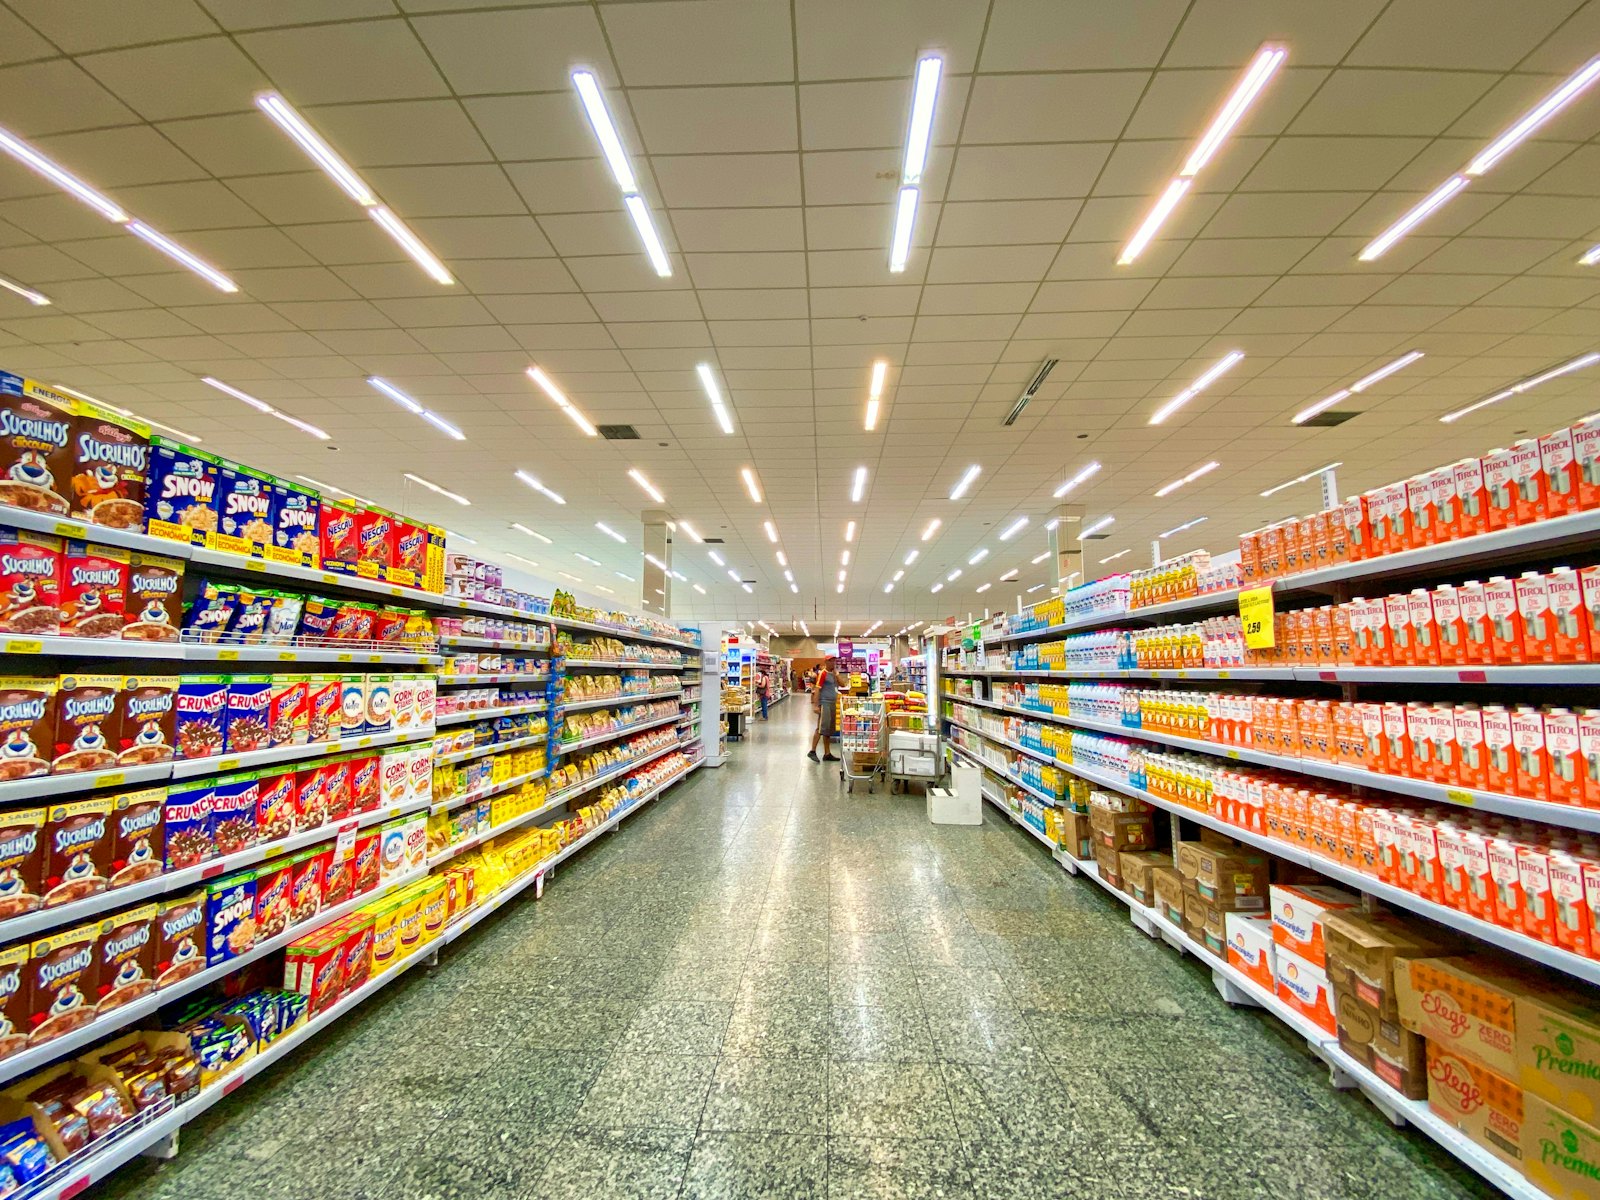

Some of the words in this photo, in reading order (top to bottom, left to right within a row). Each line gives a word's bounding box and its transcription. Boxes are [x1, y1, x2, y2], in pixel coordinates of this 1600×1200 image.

[0, 410, 69, 447] SUCRILHOS
[80, 434, 146, 471] SUCRILHOS
[1542, 440, 1572, 454] TIROL
[1484, 459, 1511, 473] TIROL
[1512, 451, 1538, 465] TIROL
[1431, 478, 1454, 489] TIROL
[1456, 469, 1480, 481] TIROL
[162, 475, 215, 498] SNOW
[226, 492, 270, 514] SNOW
[279, 508, 316, 528] SNOW
[328, 517, 354, 537] NESCAU
[150, 527, 190, 542] ECONÔMICA
[361, 521, 390, 543] NESCAU
[399, 533, 424, 553] NESCAU
[2, 555, 54, 576] SUCRILHOS
[72, 567, 120, 586] SUCRILHOS
[133, 574, 177, 593] SUCRILHOS
[1487, 591, 1513, 601] TIROL
[1519, 587, 1546, 597] TIROL
[1549, 583, 1577, 593] TIROL
[1434, 599, 1457, 608] TIROL
[1460, 595, 1483, 604] TIROL
[194, 608, 233, 625] SNOW
[177, 690, 226, 710] CRUNCH
[228, 689, 271, 709] CRUNCH
[278, 687, 305, 711] NESCAU
[315, 687, 339, 708] NESCAU
[394, 689, 412, 704] CORN
[417, 689, 433, 702] CORN
[0, 698, 47, 720] CRILHOS
[65, 694, 116, 720] SUCRILHOS
[128, 694, 173, 718] SUCRILHOS
[1429, 717, 1453, 726] TIROL
[1455, 719, 1479, 729] TIROL
[1485, 721, 1509, 730] TIROL
[1513, 722, 1541, 733] TIROL
[1546, 724, 1576, 735] TIROL
[355, 761, 377, 787] NESCAU
[385, 761, 405, 778] CORN
[411, 757, 429, 772] CORN
[214, 787, 258, 810] CRUNCH
[261, 781, 292, 812] NESCAU
[300, 774, 326, 803] NESCAU
[166, 797, 214, 820] CRUNCH
[120, 806, 161, 838] SUCRILHOS
[56, 818, 105, 853] SUCRILHOS
[408, 828, 425, 846] CORN
[356, 838, 380, 867] NESCAU
[293, 861, 319, 899] NESCAU
[1550, 869, 1579, 884] TIROL
[163, 906, 202, 940] SUCRILHOS
[213, 896, 254, 934] SNOW
[105, 924, 150, 963] SUCRILHOS
[347, 930, 372, 963] NESCAU
[39, 945, 92, 988] SUCRILHOS
[317, 948, 343, 986] NESCAU
[1479, 1022, 1512, 1046] ZERO
[1489, 1108, 1520, 1134] ZERO
